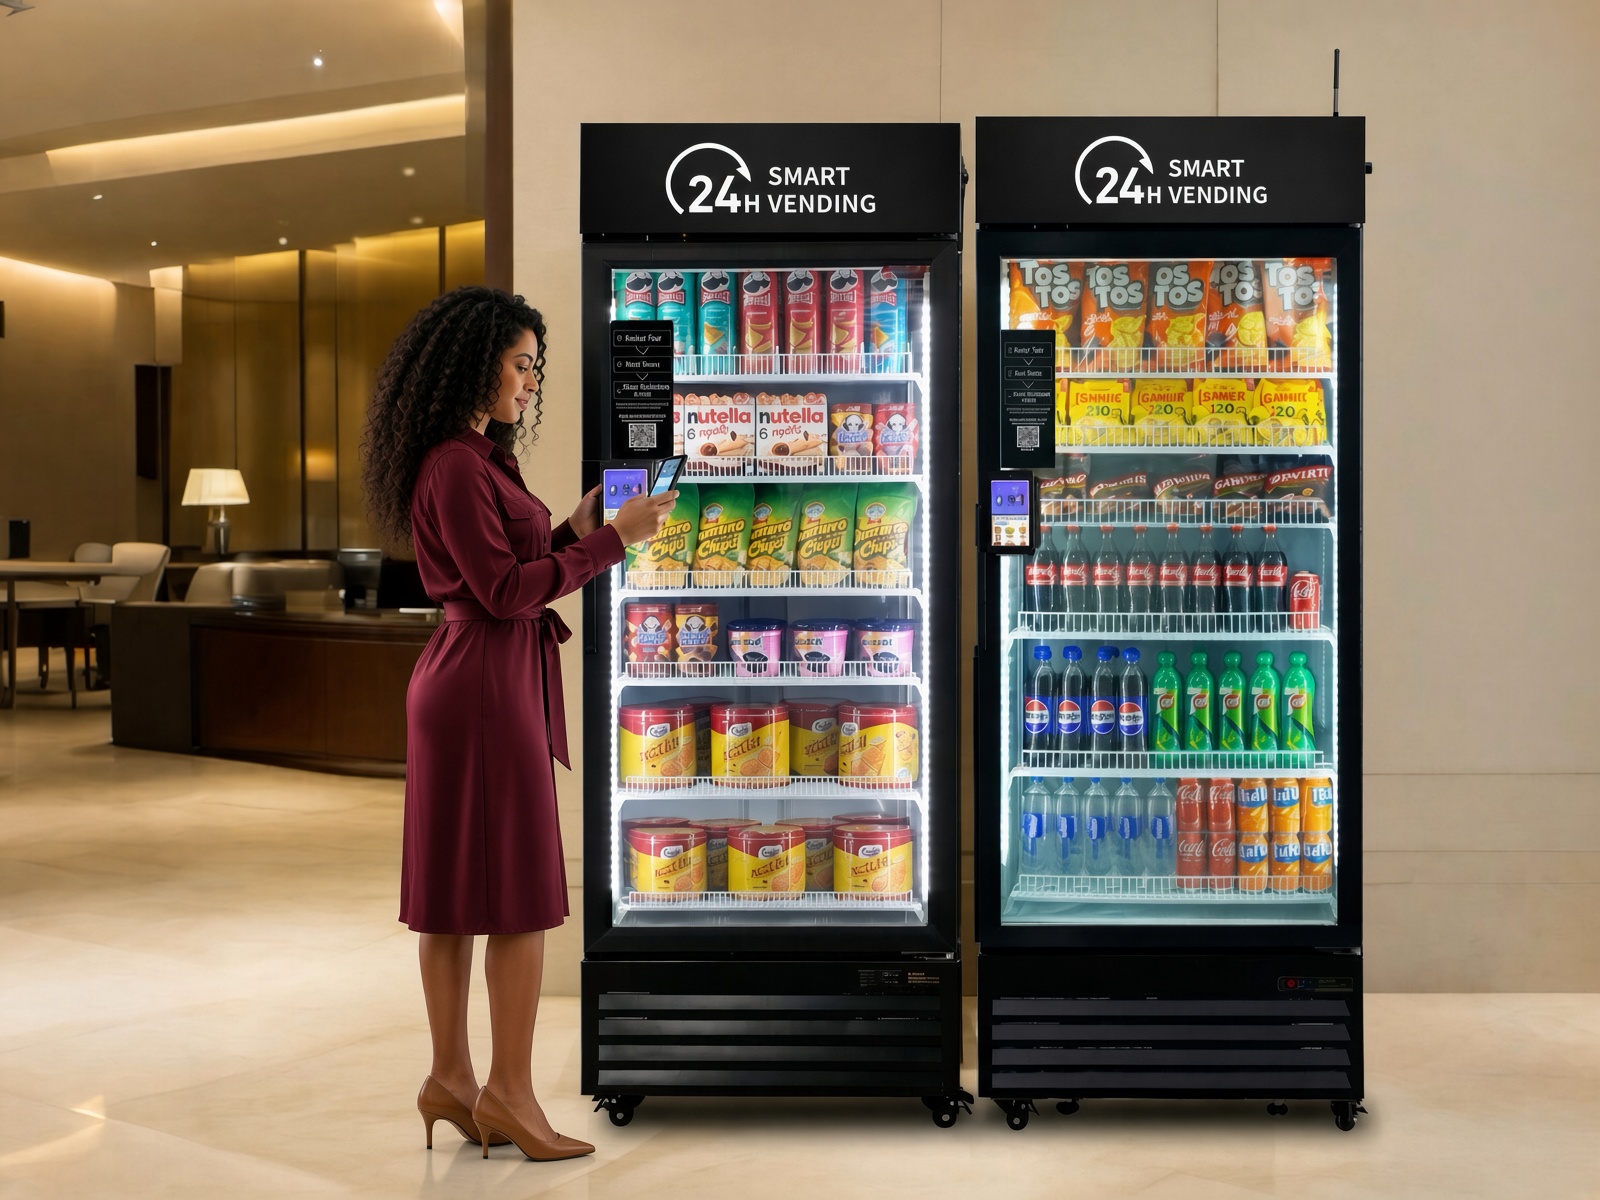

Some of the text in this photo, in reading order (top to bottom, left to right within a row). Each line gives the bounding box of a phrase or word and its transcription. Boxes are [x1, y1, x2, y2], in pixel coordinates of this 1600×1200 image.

[768, 166, 850, 186] SMART
[1168, 159, 1245, 178] SMART
[768, 194, 876, 213] VENDING
[1168, 186, 1267, 204] VENDING
[1019, 260, 1071, 286] TOS
[1265, 262, 1315, 287] TOS
[1035, 280, 1081, 308] TOS
[1095, 281, 1144, 308] TOS
[1154, 280, 1203, 306] TOS
[687, 407, 751, 424] nutella
[760, 407, 824, 424] nutella
[687, 428, 696, 440] 6
[760, 428, 769, 440] 6
